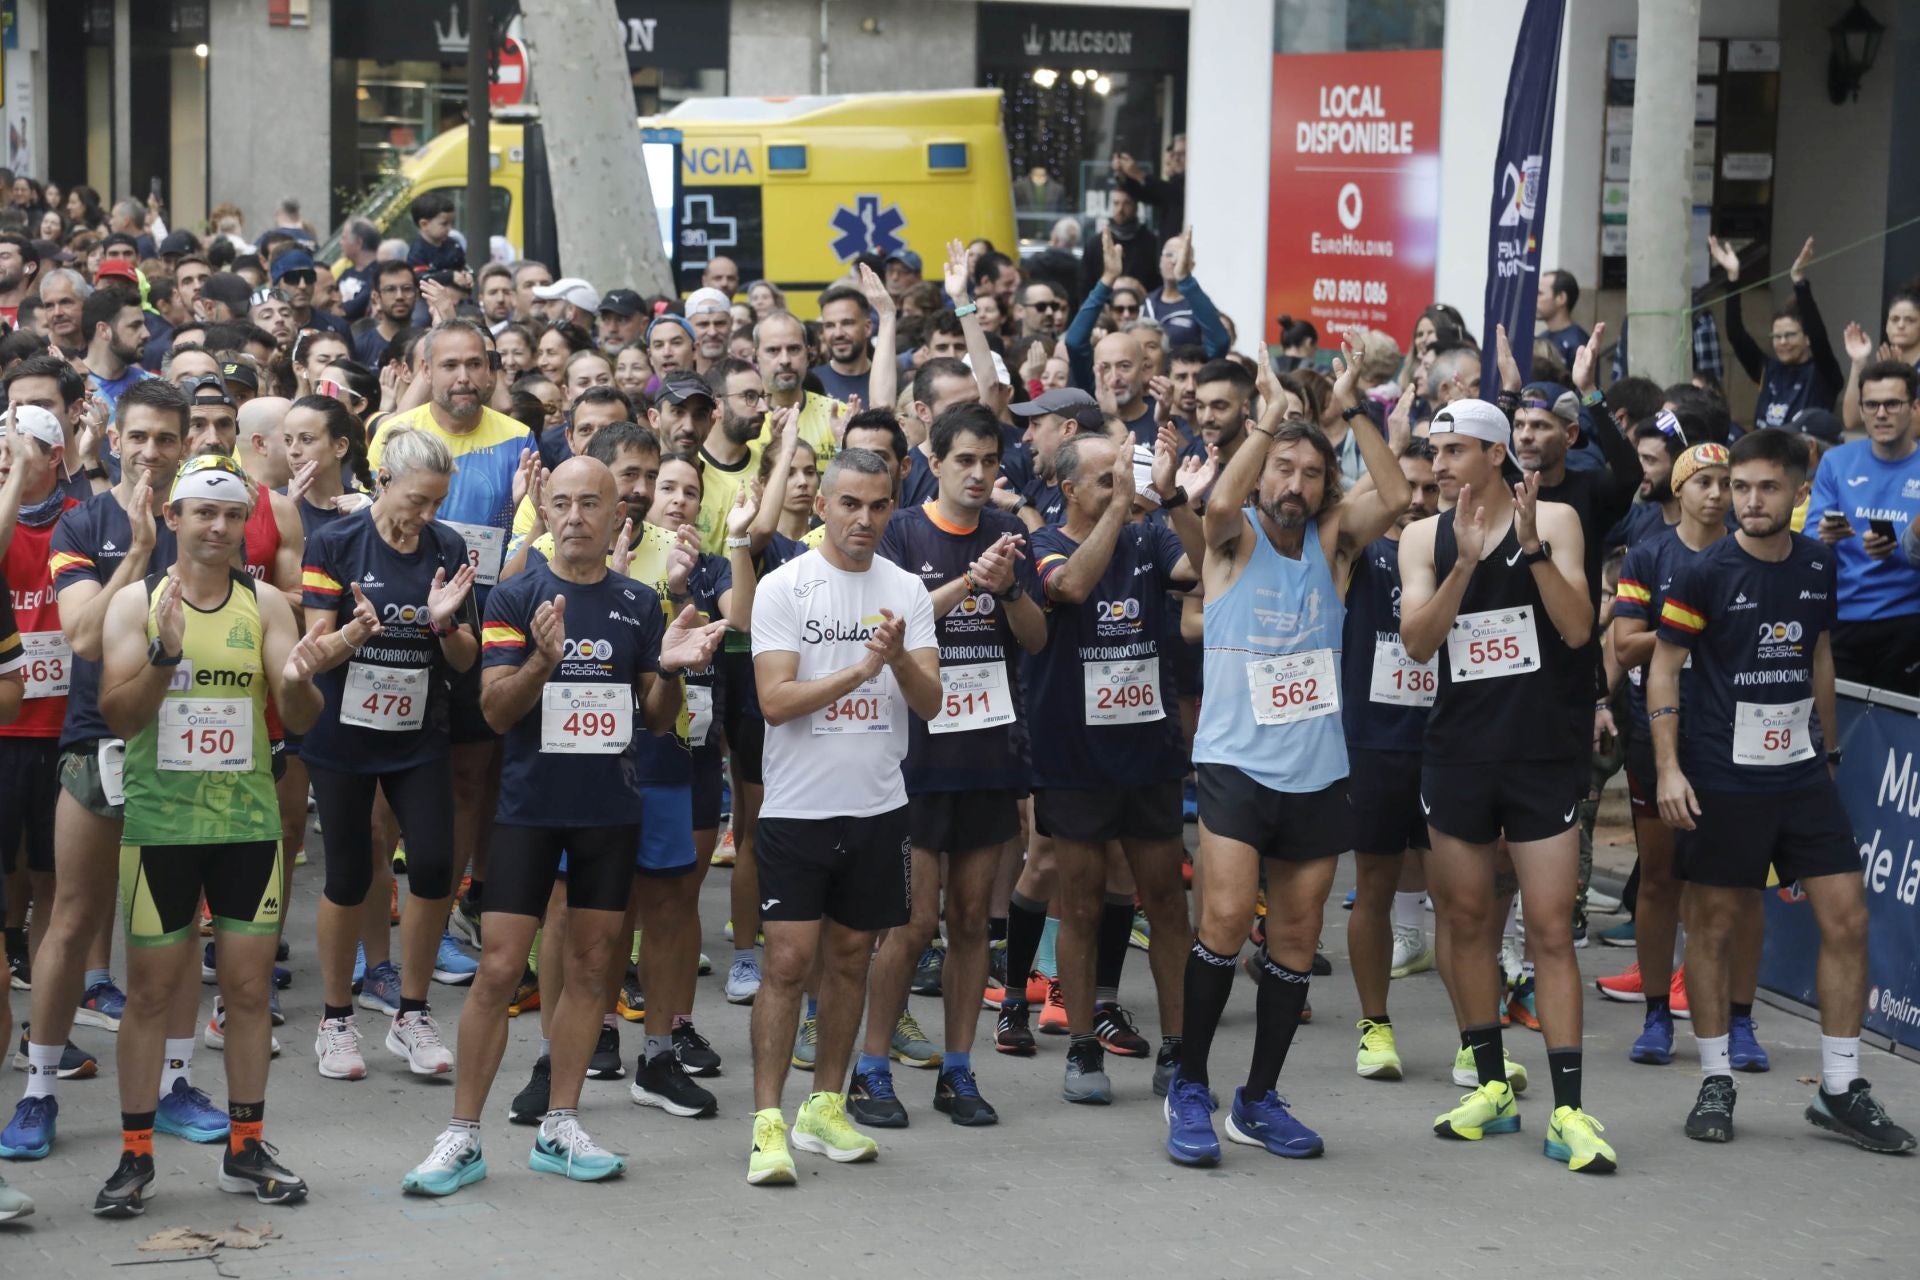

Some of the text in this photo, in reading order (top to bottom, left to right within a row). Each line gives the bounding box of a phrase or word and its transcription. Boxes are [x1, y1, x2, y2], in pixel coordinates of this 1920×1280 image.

[1050, 30, 1132, 54] MACSON
[1320, 85, 1385, 118] LOCAL
[1296, 121, 1413, 154] DISPONIBLE
[1313, 279, 1387, 305] 670 890 086
[1856, 506, 1908, 523] BALEARIA
[945, 618, 986, 626] POLICIA
[1097, 598, 1140, 622] 200
[1759, 621, 1802, 645] 200
[563, 638, 613, 660] 200
[1469, 636, 1520, 665] 555
[561, 669, 613, 677] NACIONAL
[1392, 669, 1435, 692] 136
[362, 693, 412, 717] 478
[946, 691, 990, 717] 511
[1097, 684, 1154, 708] 2496
[1272, 678, 1319, 708] 562
[825, 698, 879, 721] 3401
[562, 712, 616, 736] 499
[180, 729, 235, 754] 150
[1763, 728, 1792, 751] 59
